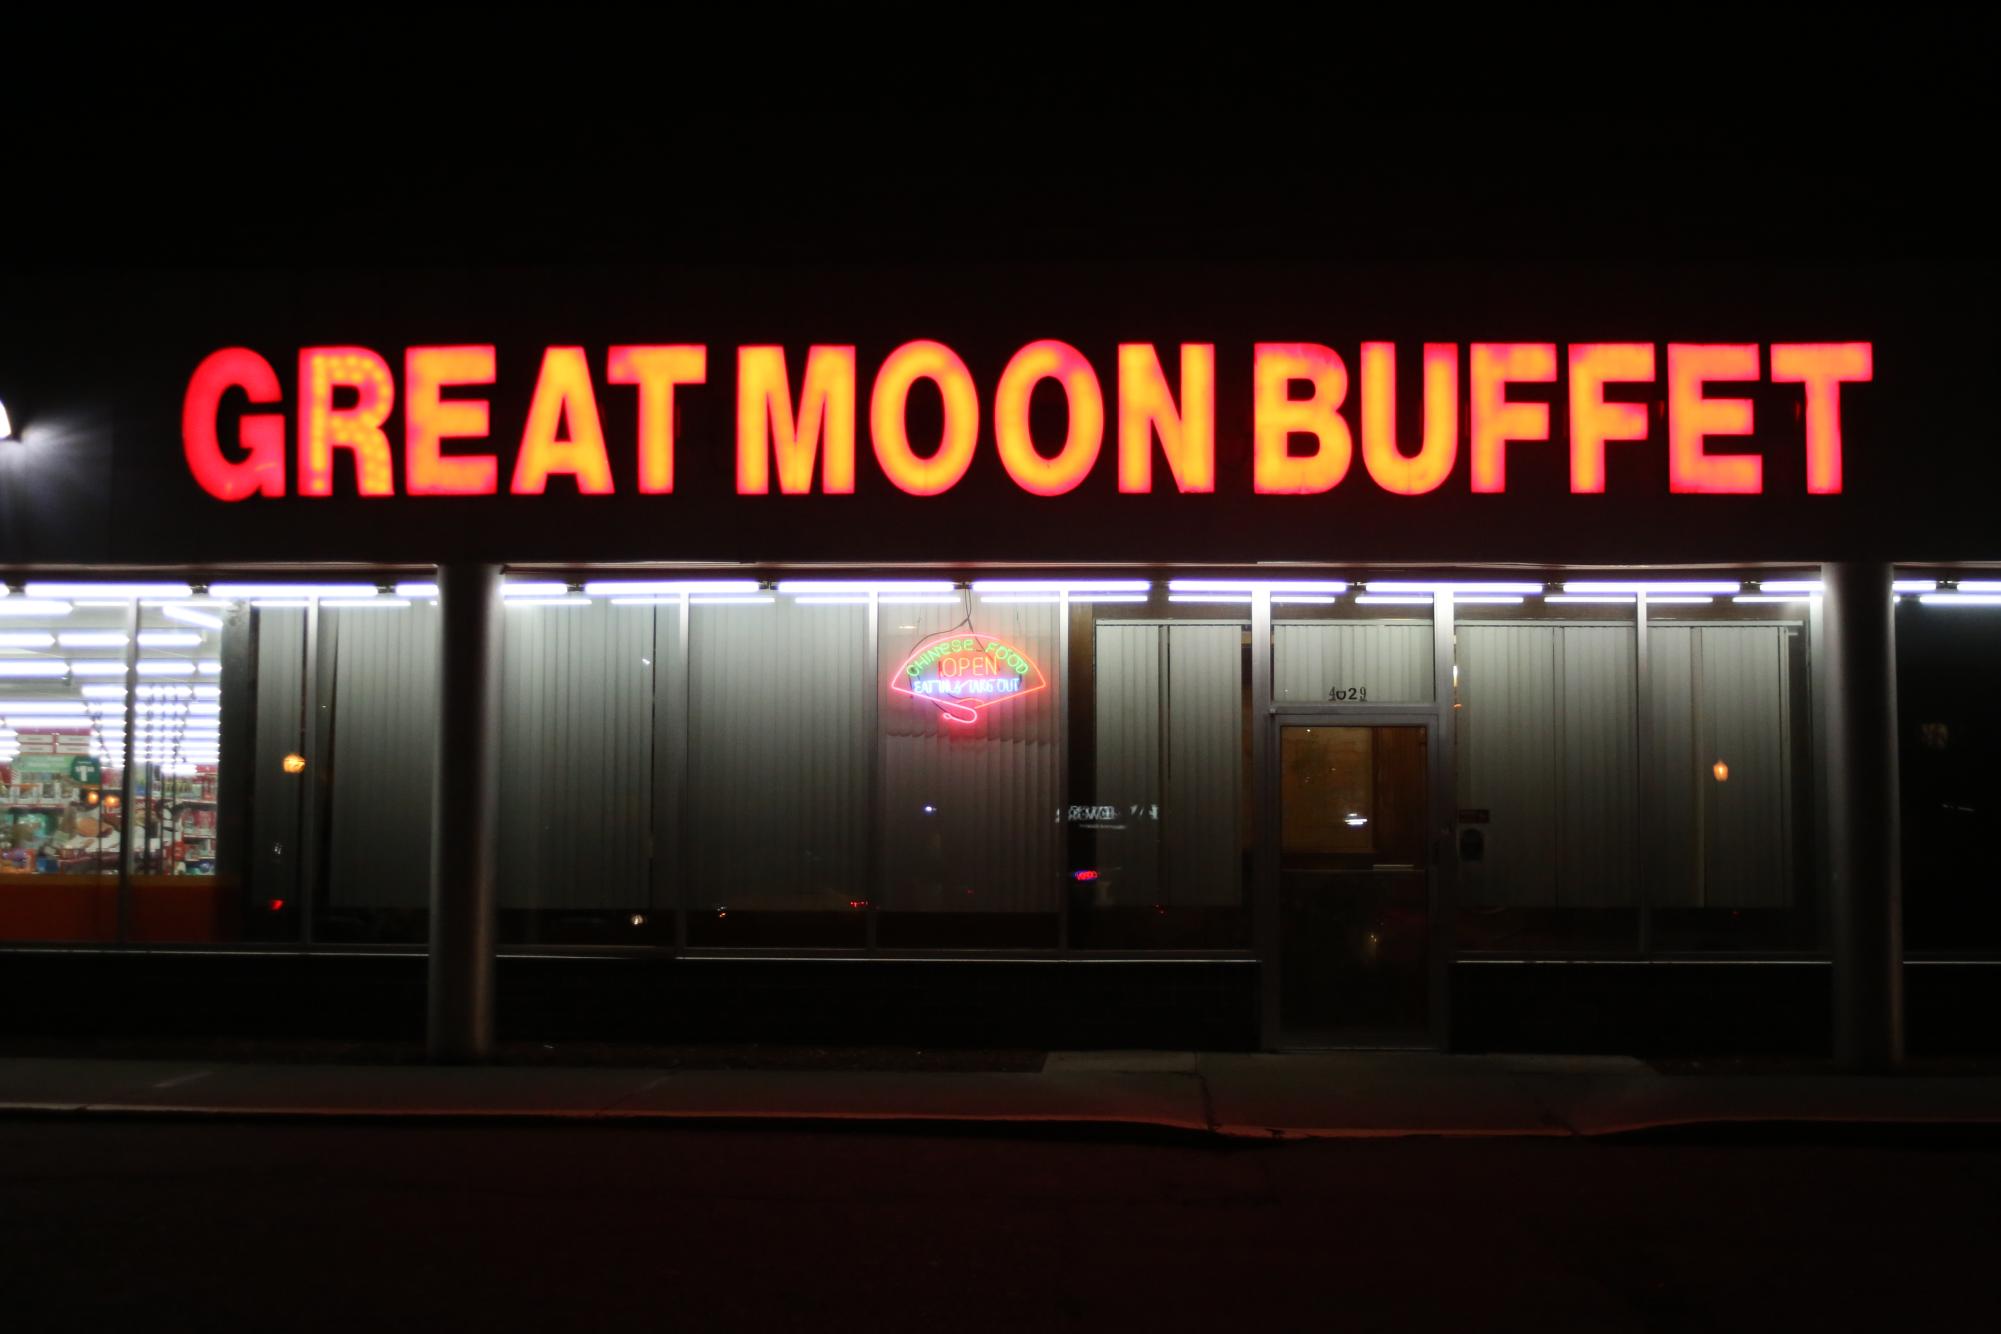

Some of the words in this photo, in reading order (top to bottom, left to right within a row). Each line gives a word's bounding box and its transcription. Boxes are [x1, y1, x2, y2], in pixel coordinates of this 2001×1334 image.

[182, 343, 707, 501] GREAT
[736, 339, 1216, 497] MOON
[1253, 341, 1873, 497] BUFFET
[941, 656, 999, 677] OPEN
[985, 642, 1029, 675] FOOD
[913, 679, 934, 695] EAT
[996, 678, 1021, 693] OUT
[1328, 686, 1367, 702] 4029
